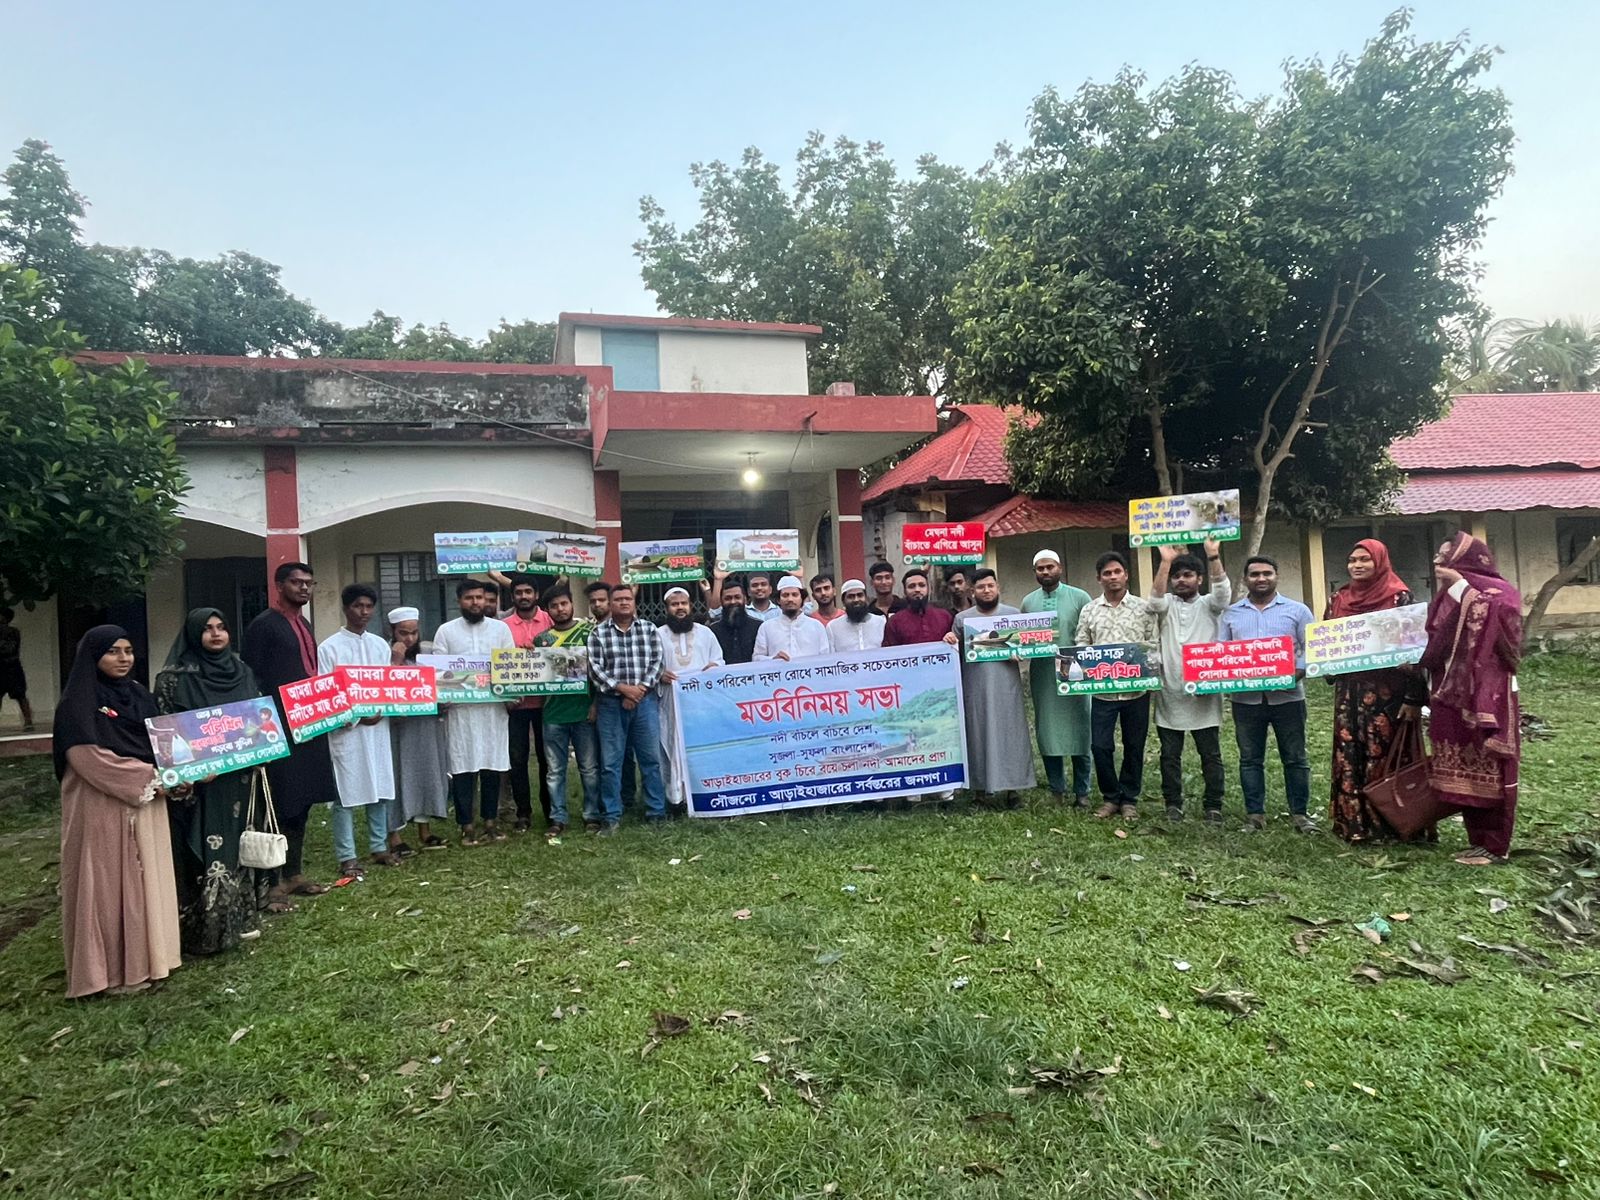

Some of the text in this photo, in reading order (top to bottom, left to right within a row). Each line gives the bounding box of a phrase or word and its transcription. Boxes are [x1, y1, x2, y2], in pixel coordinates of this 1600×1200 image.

[925, 524, 964, 537] মেঘনা নদী
[904, 538, 982, 551] বাঁচাতে এগিয়ে আসুন
[994, 618, 1009, 630] নদী
[1020, 630, 1053, 644] সম্পদ
[1076, 646, 1124, 660] নদীর শত্রু
[1227, 644, 1242, 652] বন
[448, 658, 466, 672] নদী
[1186, 658, 1214, 668] পাহাড়
[1259, 650, 1290, 662] মানেই
[345, 668, 424, 683] আমরা জেলে,
[681, 652, 952, 693] নদী ও পরিবেশ দূষণ রোধে সামাজিক সচেতনতার লক্ষ্যে
[1086, 661, 1141, 680] পলিথিন
[1199, 665, 1277, 680] সোনার বাংলাদেশ
[286, 676, 340, 700] আমরা জেলে,
[346, 683, 380, 700] দীতে
[382, 686, 408, 700] মাছ
[410, 683, 434, 700] নেই
[288, 703, 314, 723] নদীতে
[314, 698, 334, 714] মাছ
[332, 691, 350, 709] নেই
[736, 683, 902, 725] মতবিনিময় সভা
[200, 716, 244, 736] পলিথিন
[770, 730, 788, 744] নদী
[792, 728, 820, 742] বাঁচলে
[823, 726, 850, 739] বাঁচবে
[702, 770, 772, 790] আড়াইহাজারের
[776, 768, 792, 782] বুক
[795, 764, 816, 777] চিরে
[820, 762, 838, 775] বয়ে
[840, 760, 858, 772] চলা
[862, 758, 880, 770] নদী
[884, 754, 925, 768] আমাদের
[710, 792, 757, 809] সৌজন্যে
[768, 781, 852, 802] আড়াইহাজারের
[855, 776, 902, 792] সর্বস্তরের
